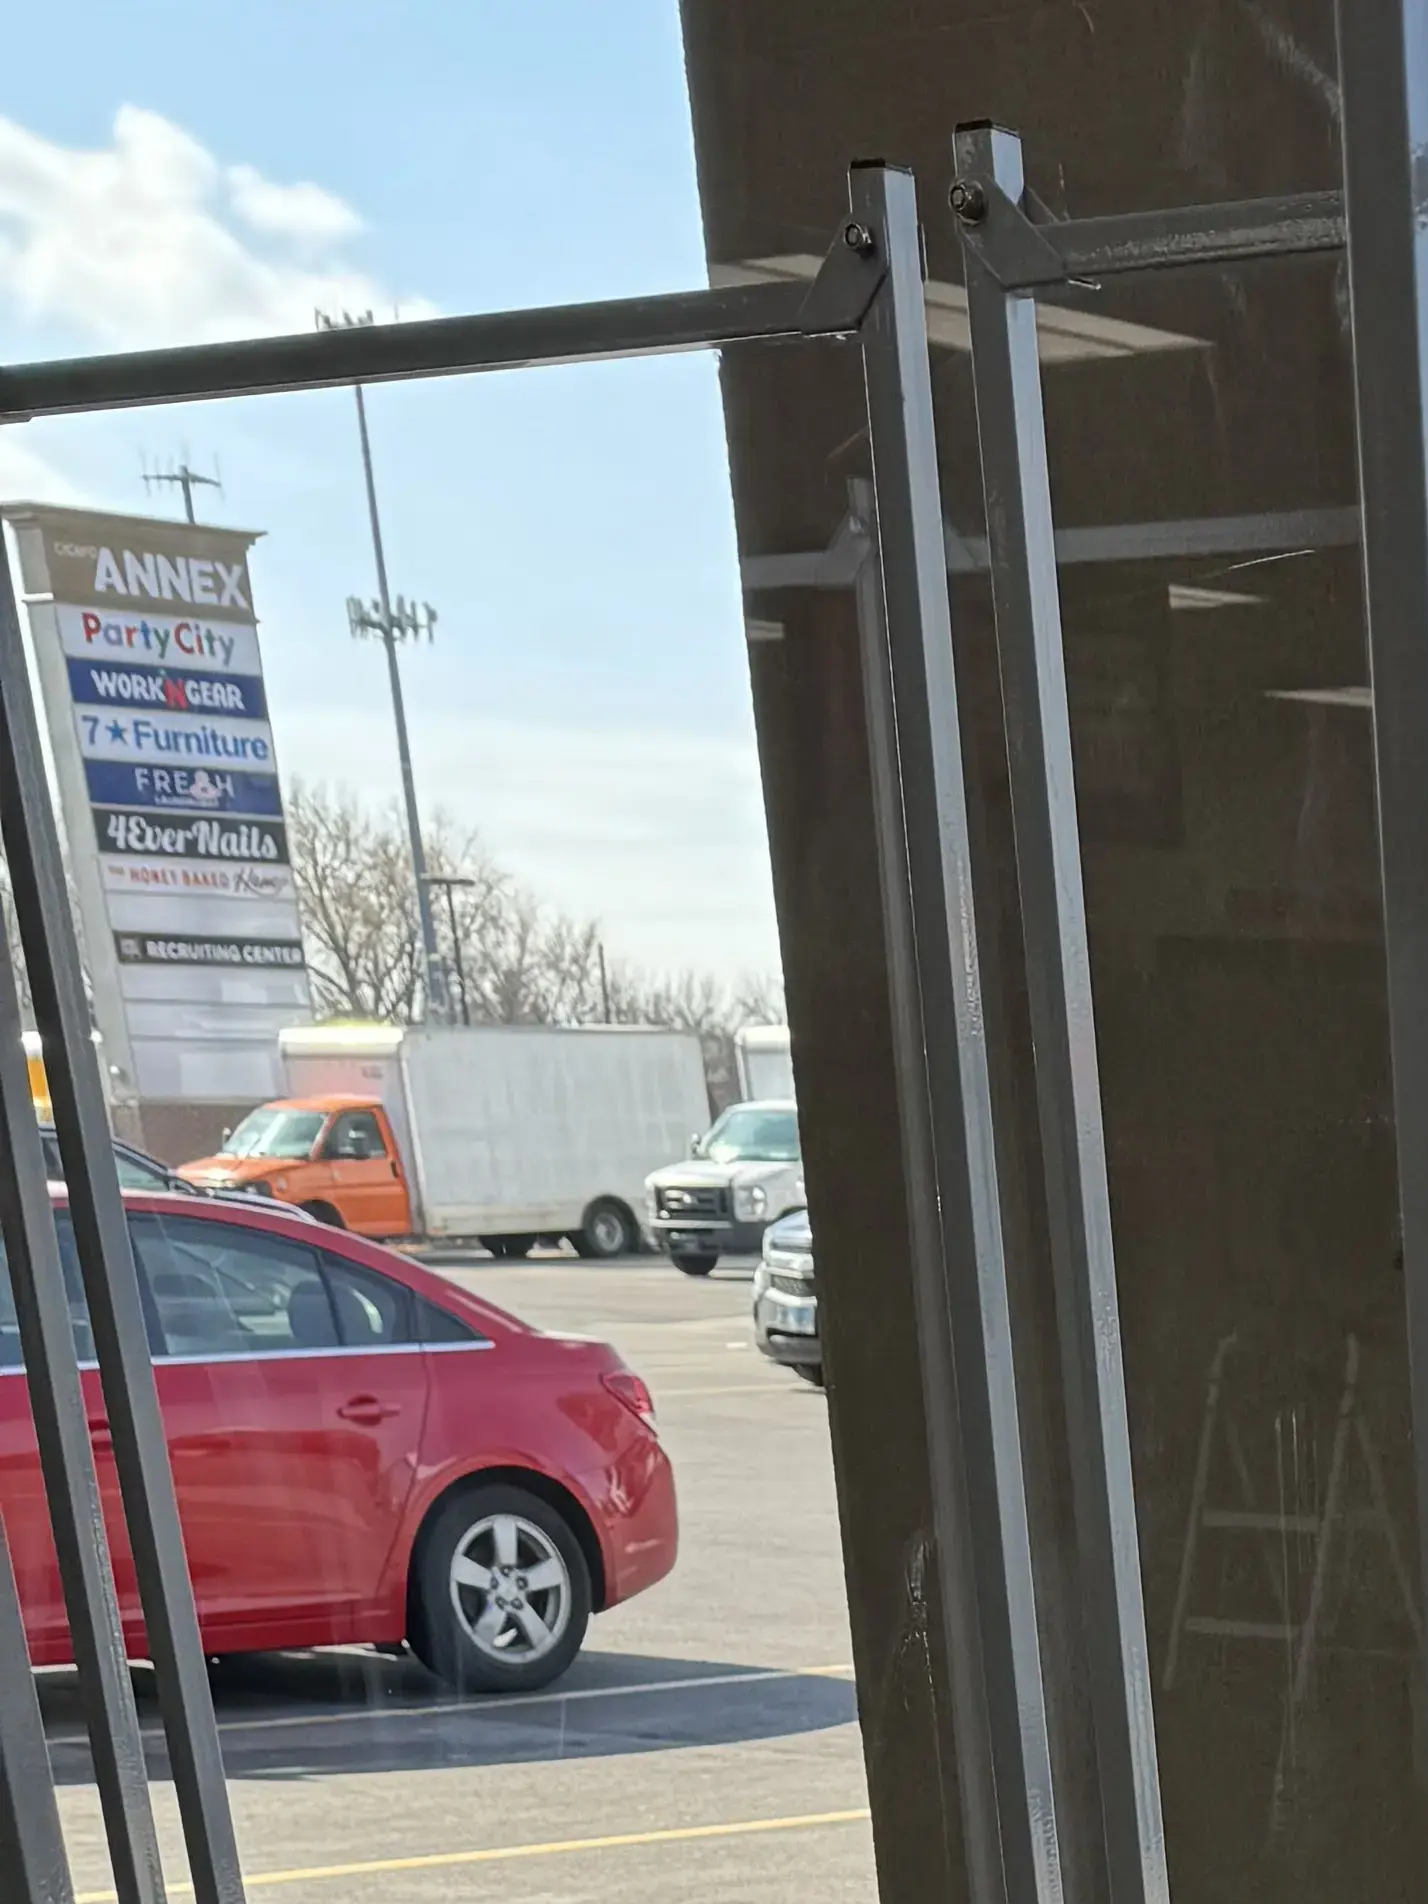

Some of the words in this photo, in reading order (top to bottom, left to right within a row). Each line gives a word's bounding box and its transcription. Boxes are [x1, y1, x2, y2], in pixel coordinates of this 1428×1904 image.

[94, 546, 249, 609] ANNEX
[82, 714, 100, 745] 7
[132, 720, 269, 761] Furniture
[134, 767, 236, 801] FREH
[146, 940, 242, 963] RECRUITING
[243, 945, 302, 964] CENTER
